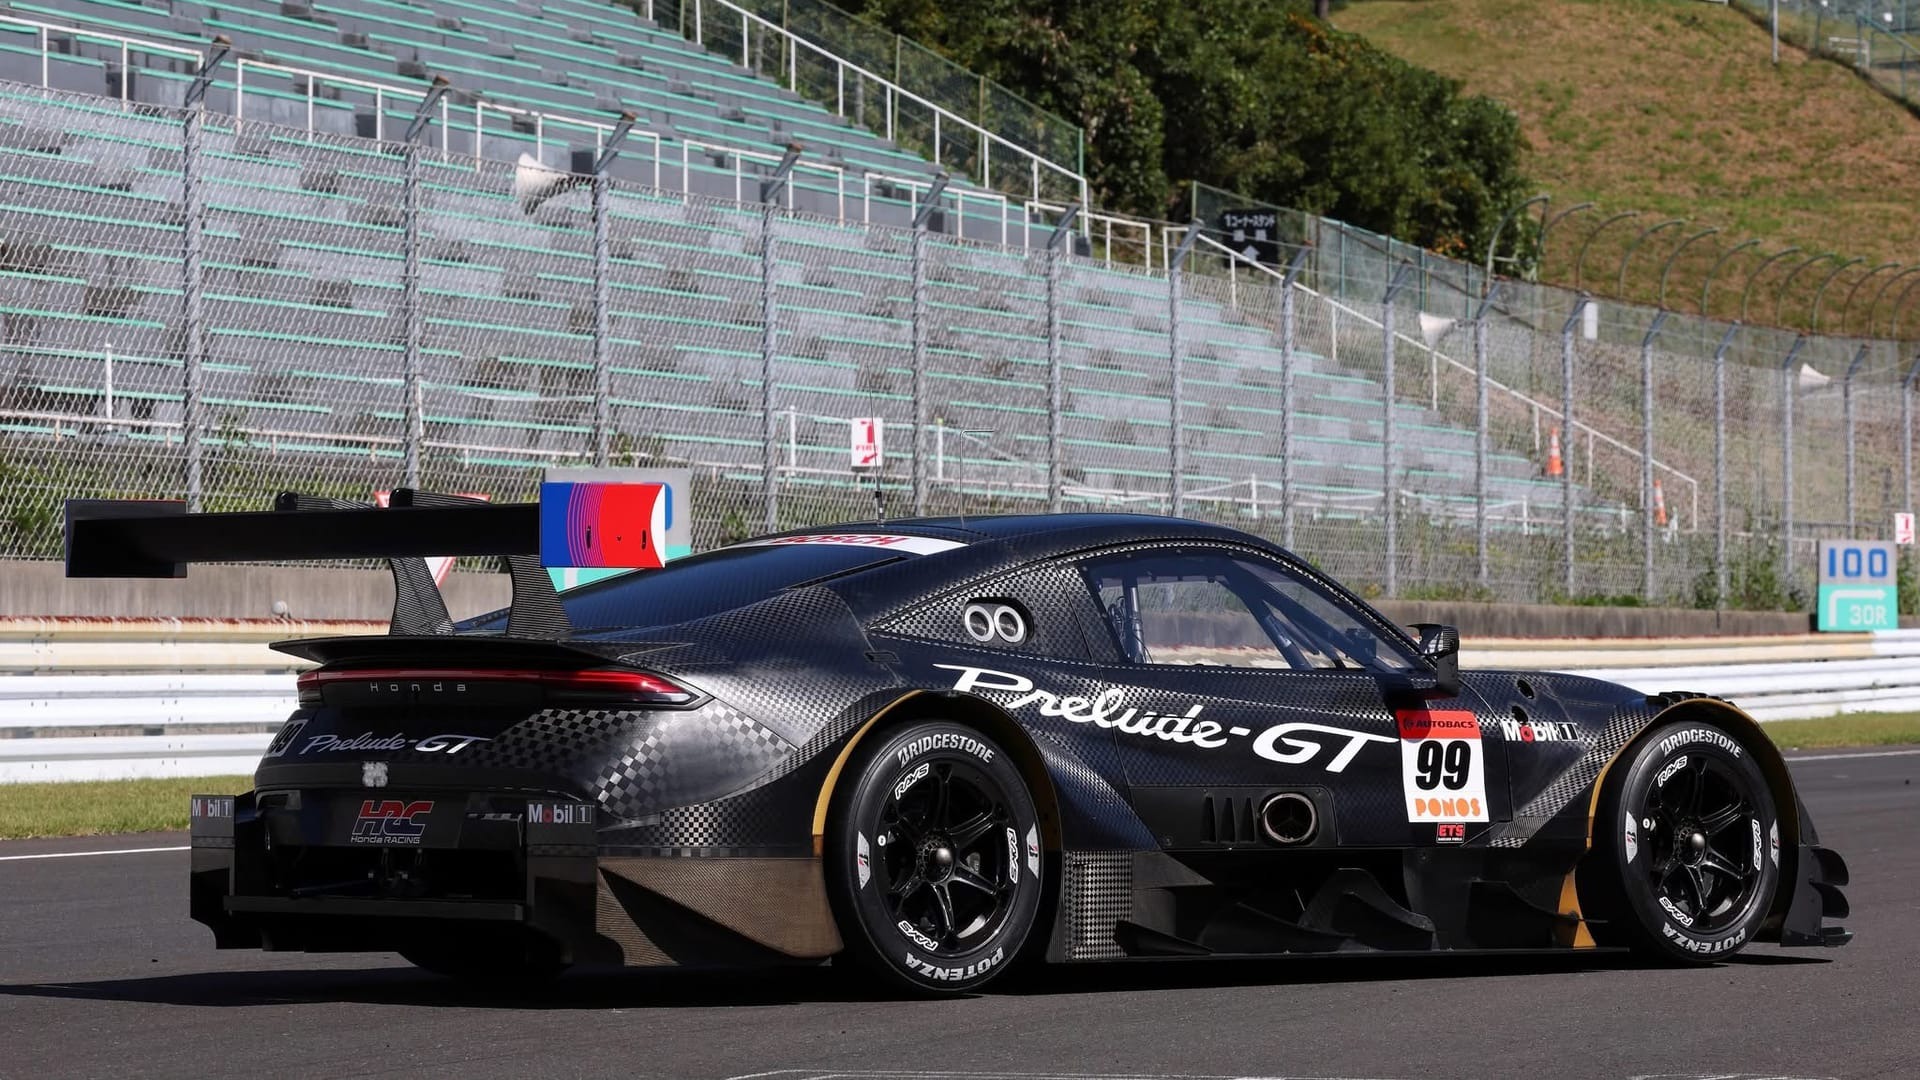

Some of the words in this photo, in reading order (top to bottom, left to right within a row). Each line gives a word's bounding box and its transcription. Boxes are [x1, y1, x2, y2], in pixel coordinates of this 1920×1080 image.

[1828, 548, 1888, 578] 100
[1850, 604, 1888, 625] 30R
[370, 681, 466, 692] Honda
[932, 662, 1399, 773] Prelude-GT
[1416, 720, 1474, 729] AUTOBACS
[1501, 721, 1557, 743] Mobil
[300, 731, 493, 756] Prelude-GT
[897, 733, 995, 768] BRIDGESTONE
[1660, 729, 1742, 758] BRIDGESTONE
[1415, 740, 1471, 790] 99
[1658, 755, 1688, 787] RAYS
[895, 763, 929, 800] RAYS
[352, 800, 434, 835] HRC
[528, 803, 573, 823] Mobil
[1415, 798, 1481, 817] PONOS
[350, 835, 383, 843] Honda
[384, 836, 420, 844] RACING
[1439, 824, 1464, 837] ETS
[1752, 818, 1762, 871] RAYS
[1007, 827, 1018, 884] RAYS
[1659, 896, 1693, 927] RAYS
[898, 920, 939, 951] RAYS
[1662, 922, 1746, 954] POTENZA
[905, 946, 1004, 982] POTENZA
